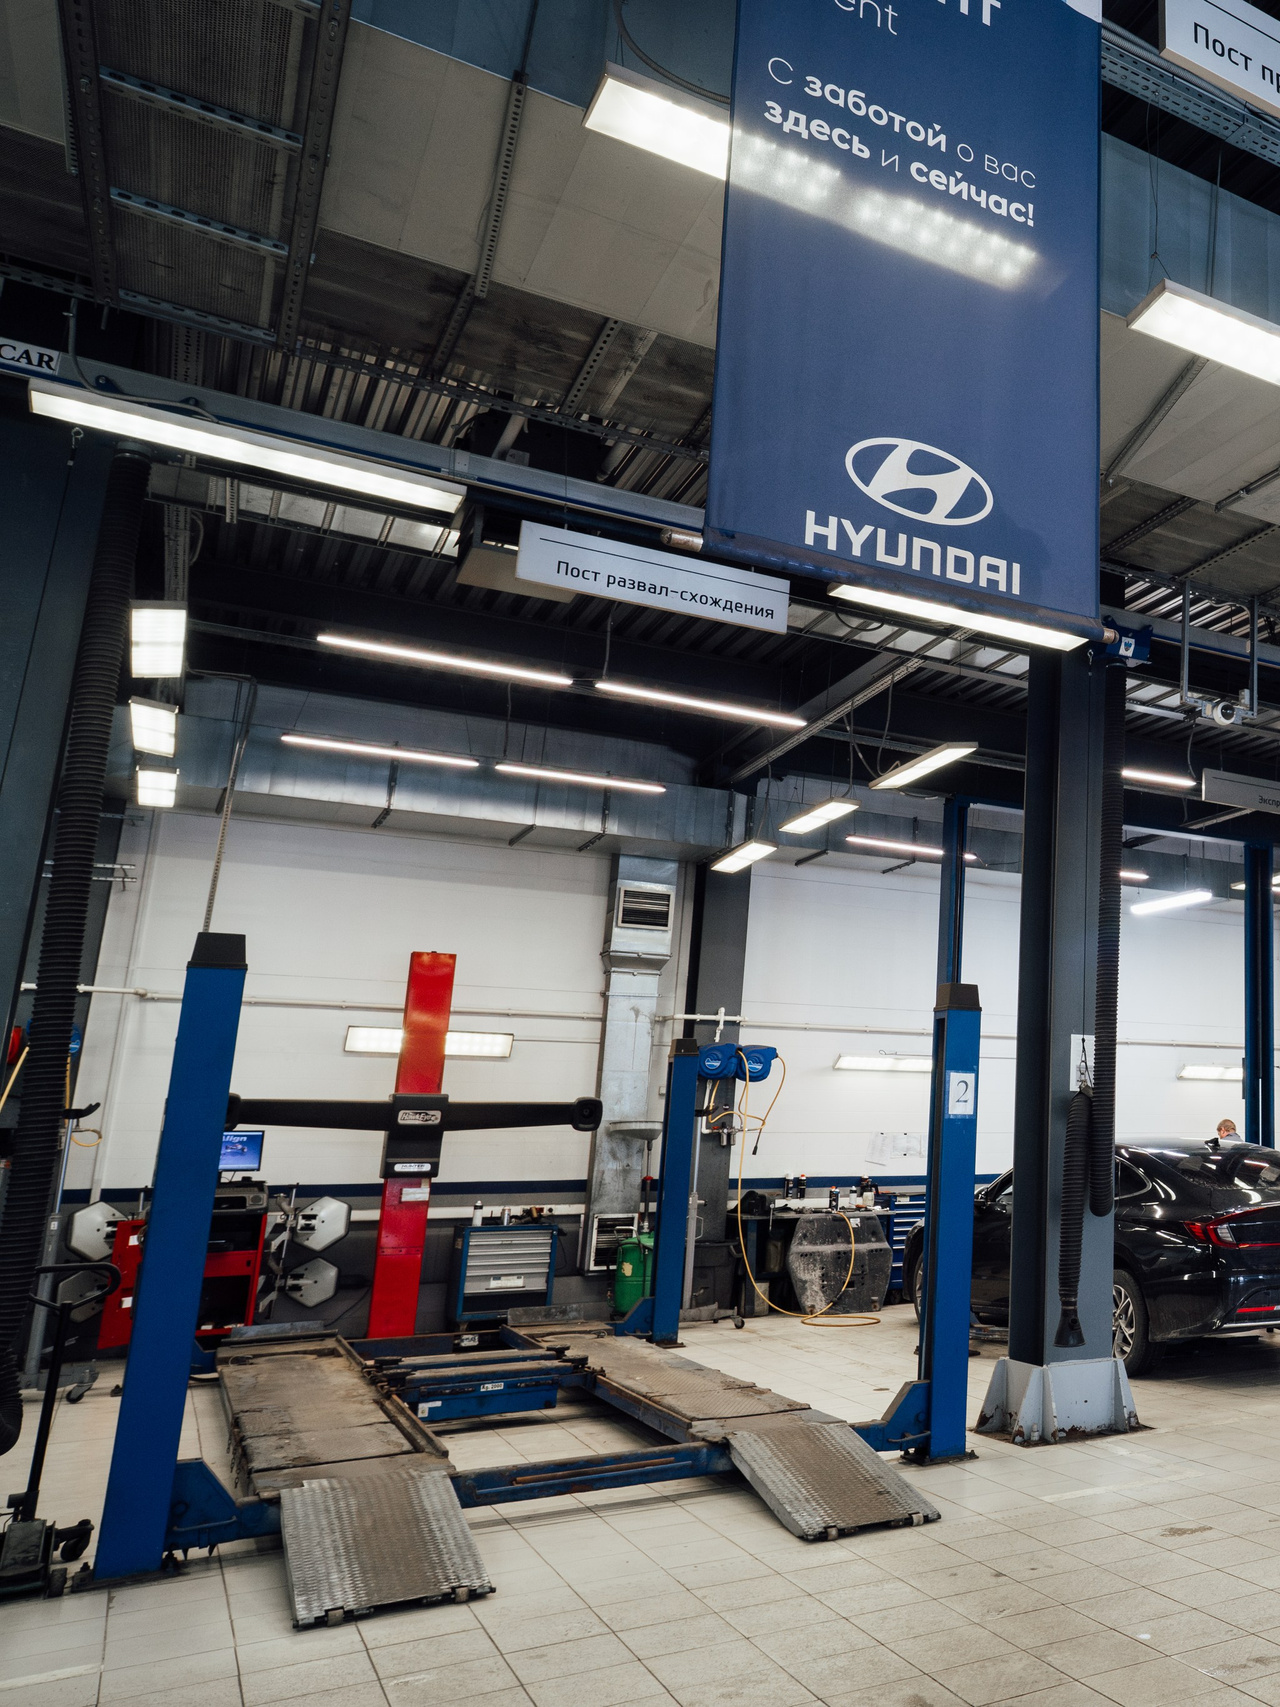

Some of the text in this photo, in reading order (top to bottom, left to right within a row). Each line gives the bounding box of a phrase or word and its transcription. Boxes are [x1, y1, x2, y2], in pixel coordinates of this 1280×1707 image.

[1193, 22, 1252, 73] Пост
[767, 57, 1037, 190] С заботой о вас
[764, 99, 1034, 228] здесь и сейчас!
[804, 509, 1021, 595] HYUNDAI
[556, 560, 775, 620] Пост развал-схождения
[956, 1080, 969, 1103] 2
